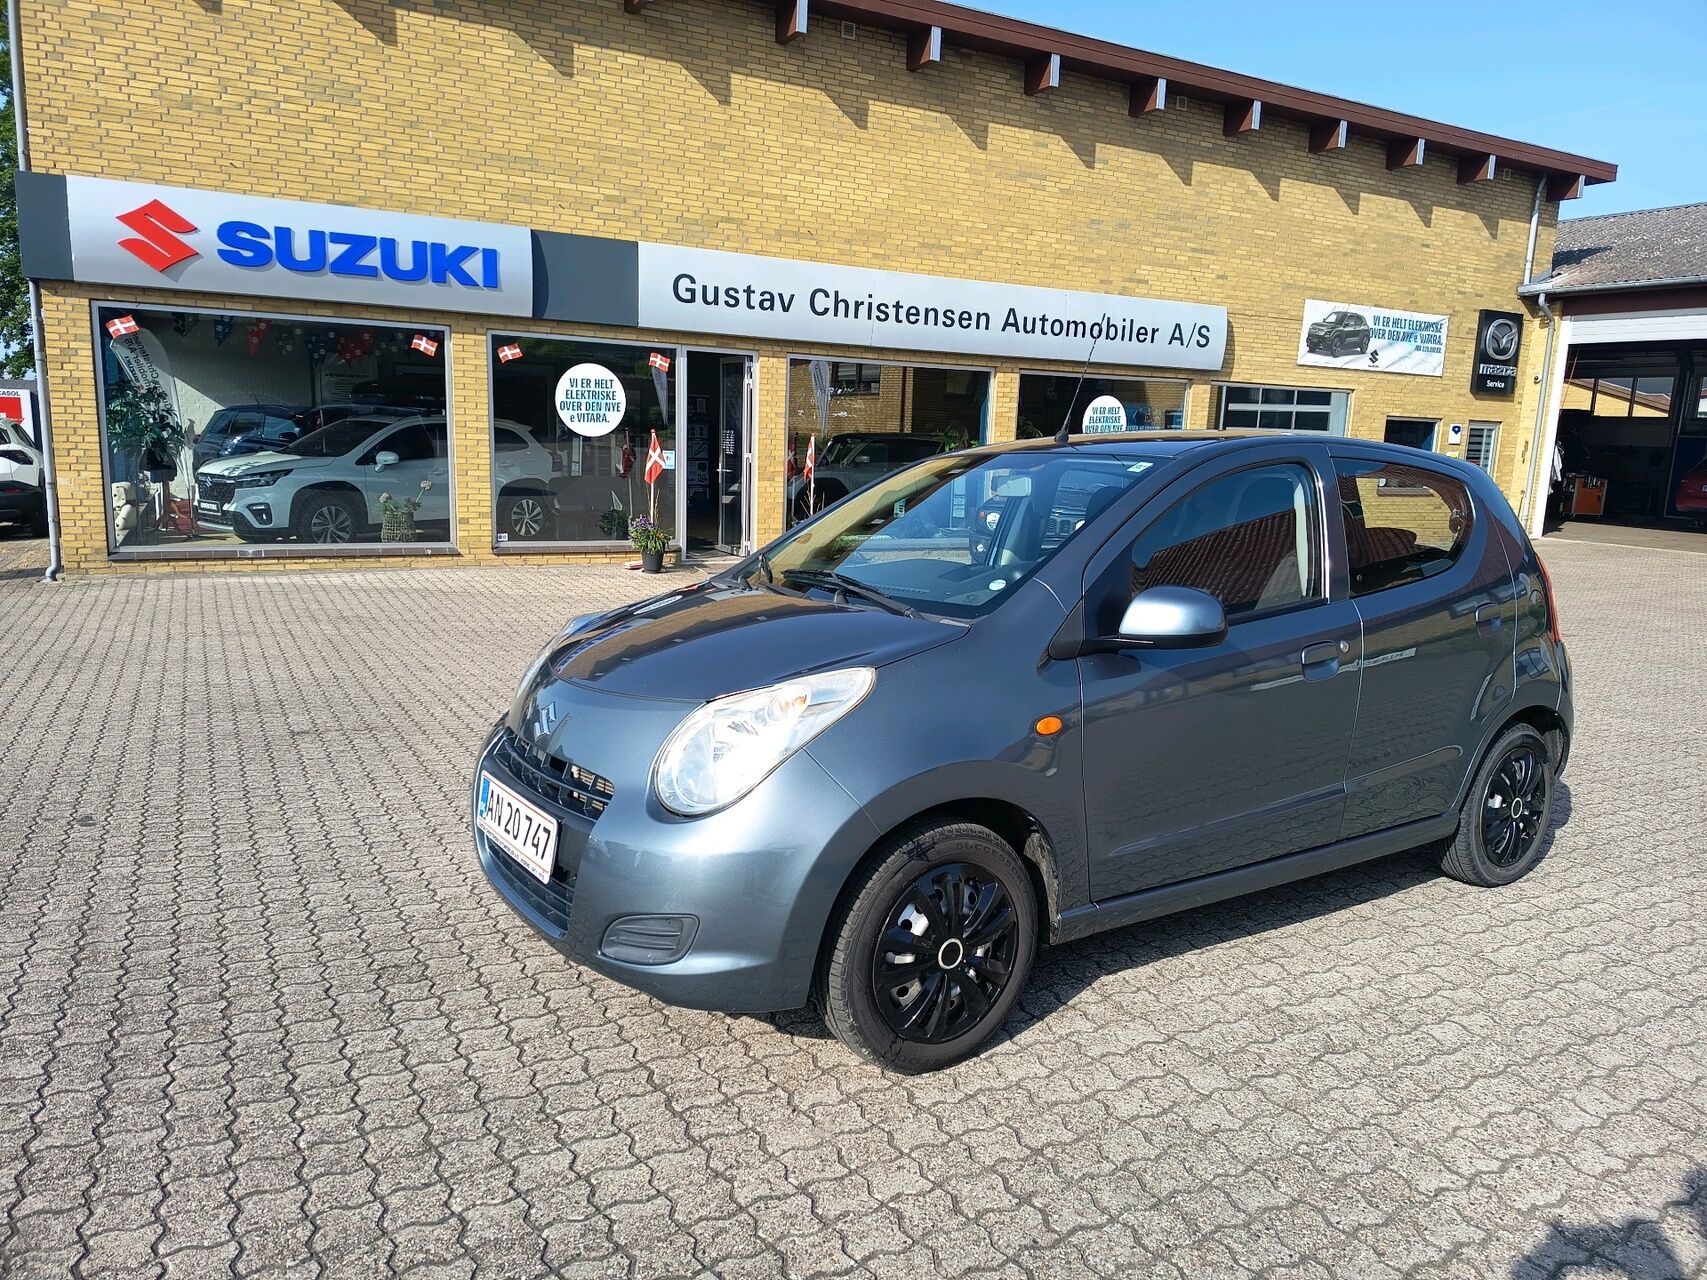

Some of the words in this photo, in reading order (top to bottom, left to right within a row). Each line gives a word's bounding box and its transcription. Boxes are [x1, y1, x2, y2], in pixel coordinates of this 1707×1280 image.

[217, 220, 498, 288] SUZUKI
[672, 273, 795, 312] Gustav
[809, 287, 991, 330] Christensen
[1001, 307, 1159, 344] Automobiler
[1168, 322, 1211, 348] A/S
[1373, 315, 1380, 327] VI
[1382, 316, 1391, 327] ER
[1392, 317, 1407, 329] HELT
[1408, 319, 1443, 333] ELEKTRISKE
[1370, 328, 1386, 340] OVER
[1387, 330, 1400, 341] DEN
[1479, 363, 1517, 376] mazda
[569, 377, 577, 388] VI
[580, 378, 591, 388] ER
[594, 379, 614, 389] HELT
[1486, 379, 1505, 388] Service
[565, 389, 616, 400] ELEKTRISKE
[560, 400, 582, 411] OVER
[585, 401, 602, 412] DEN
[604, 402, 621, 412] NYE
[1092, 407, 1098, 415] VI
[570, 414, 575, 422] e
[577, 412, 610, 423] VITARA.
[1089, 416, 1121, 424] ELEKTRISKE
[1085, 425, 1098, 433] OVER
[486, 789, 504, 827] AN
[504, 802, 520, 840] 20
[523, 814, 551, 860] 747
